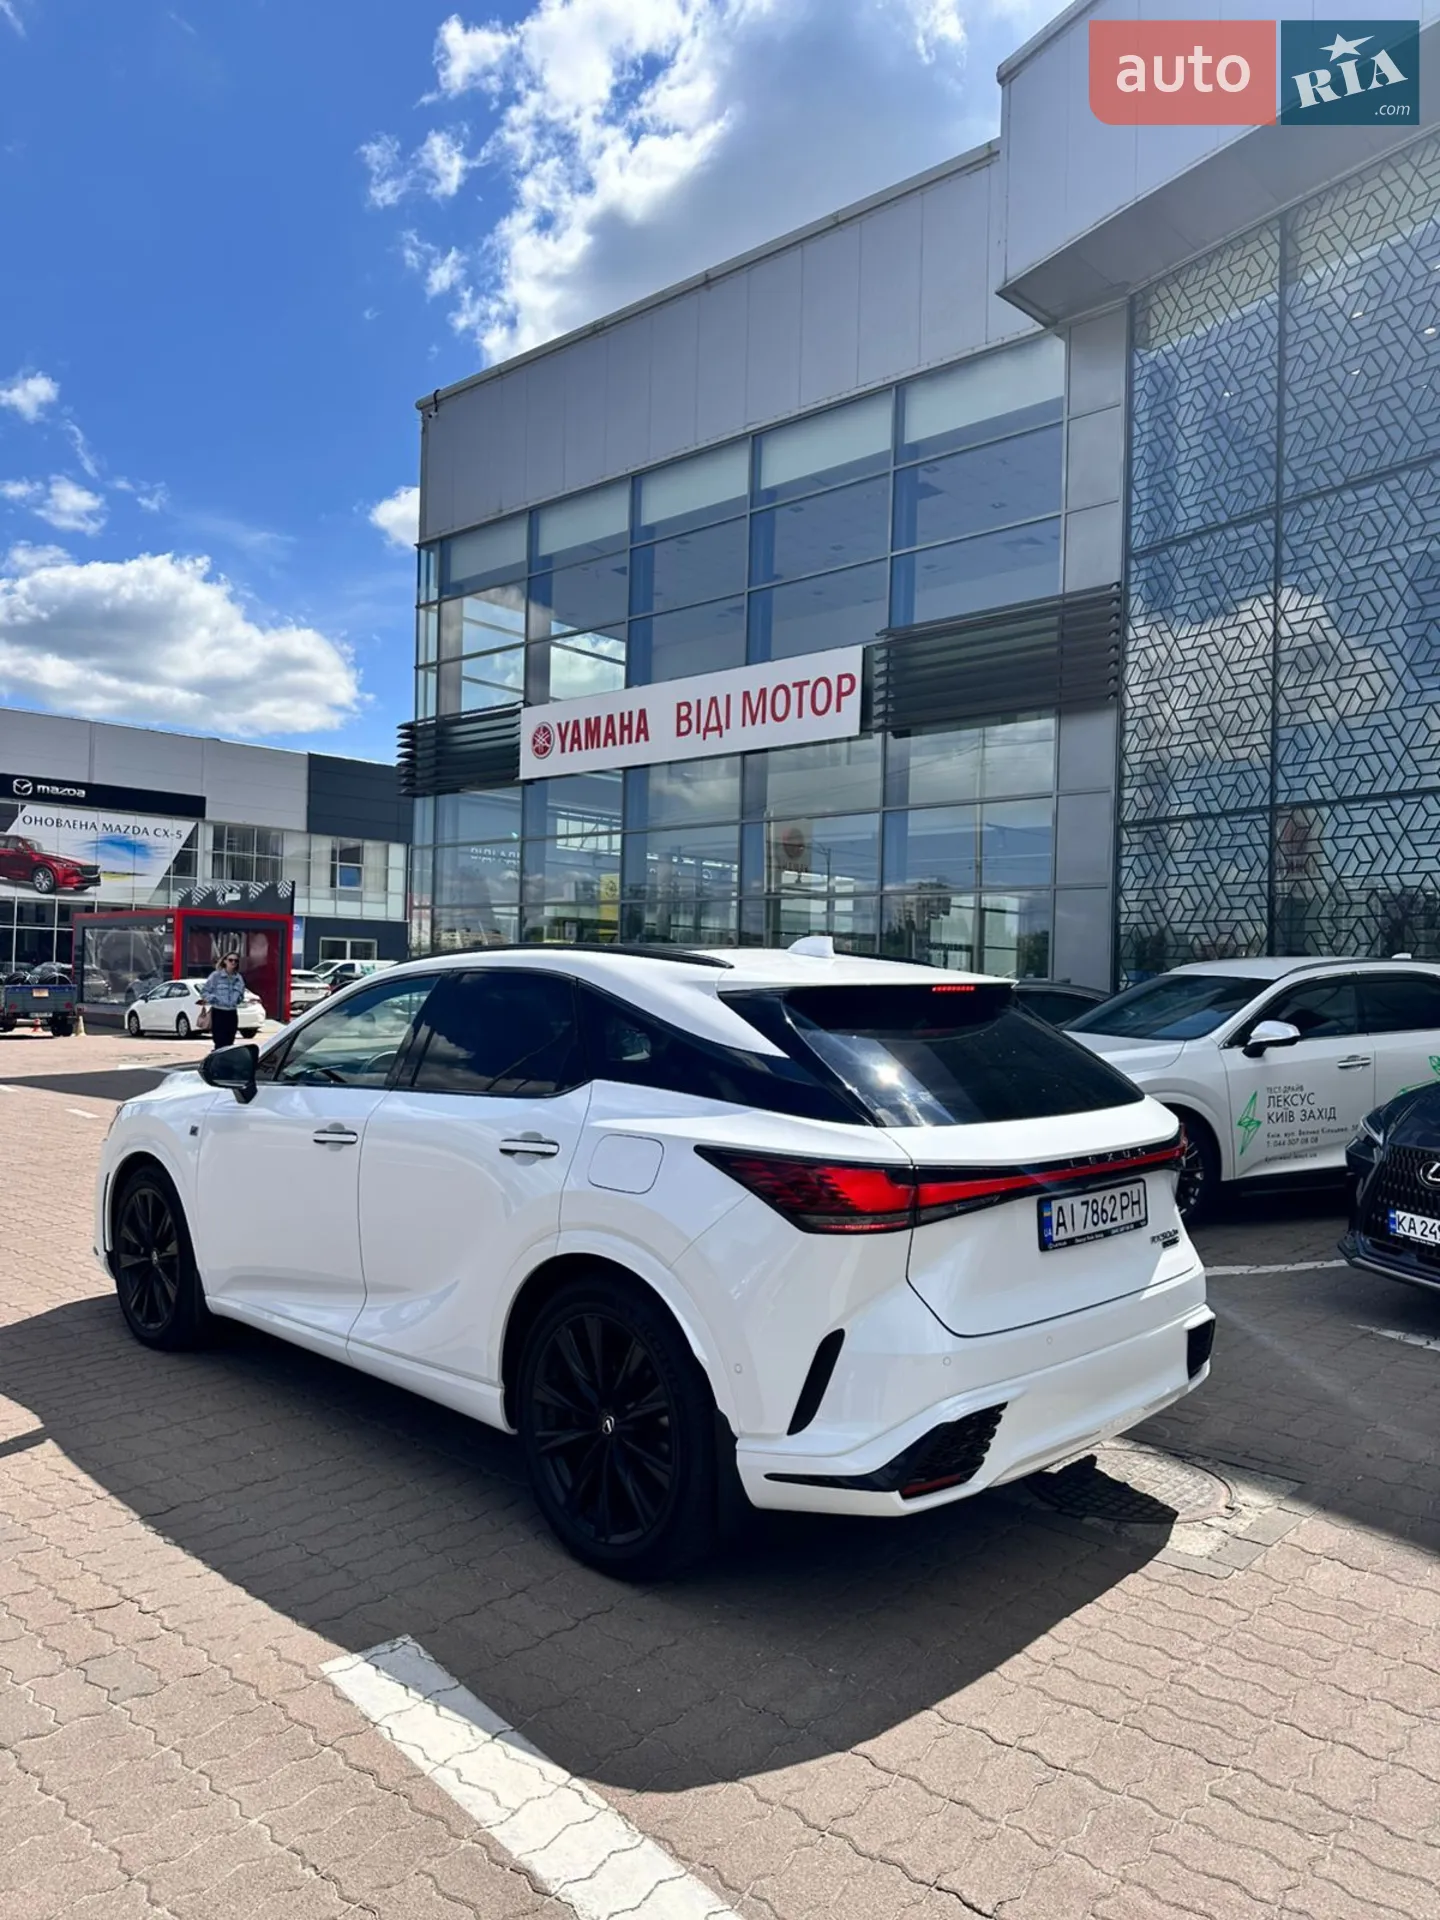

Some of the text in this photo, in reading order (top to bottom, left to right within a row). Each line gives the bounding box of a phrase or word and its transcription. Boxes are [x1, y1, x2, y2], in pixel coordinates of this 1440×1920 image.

[557, 672, 857, 754] YAMAHA ВІДІ МОТОР
[36, 783, 86, 798] mazda
[22, 815, 183, 840] ОНОВЛЕНА MAZDA CX-5
[1267, 1092, 1315, 1108] ЛЕКСУС
[1267, 1106, 1337, 1124] КИЇВ ЗАХІД
[1081, 1194, 1118, 1230] 7862
